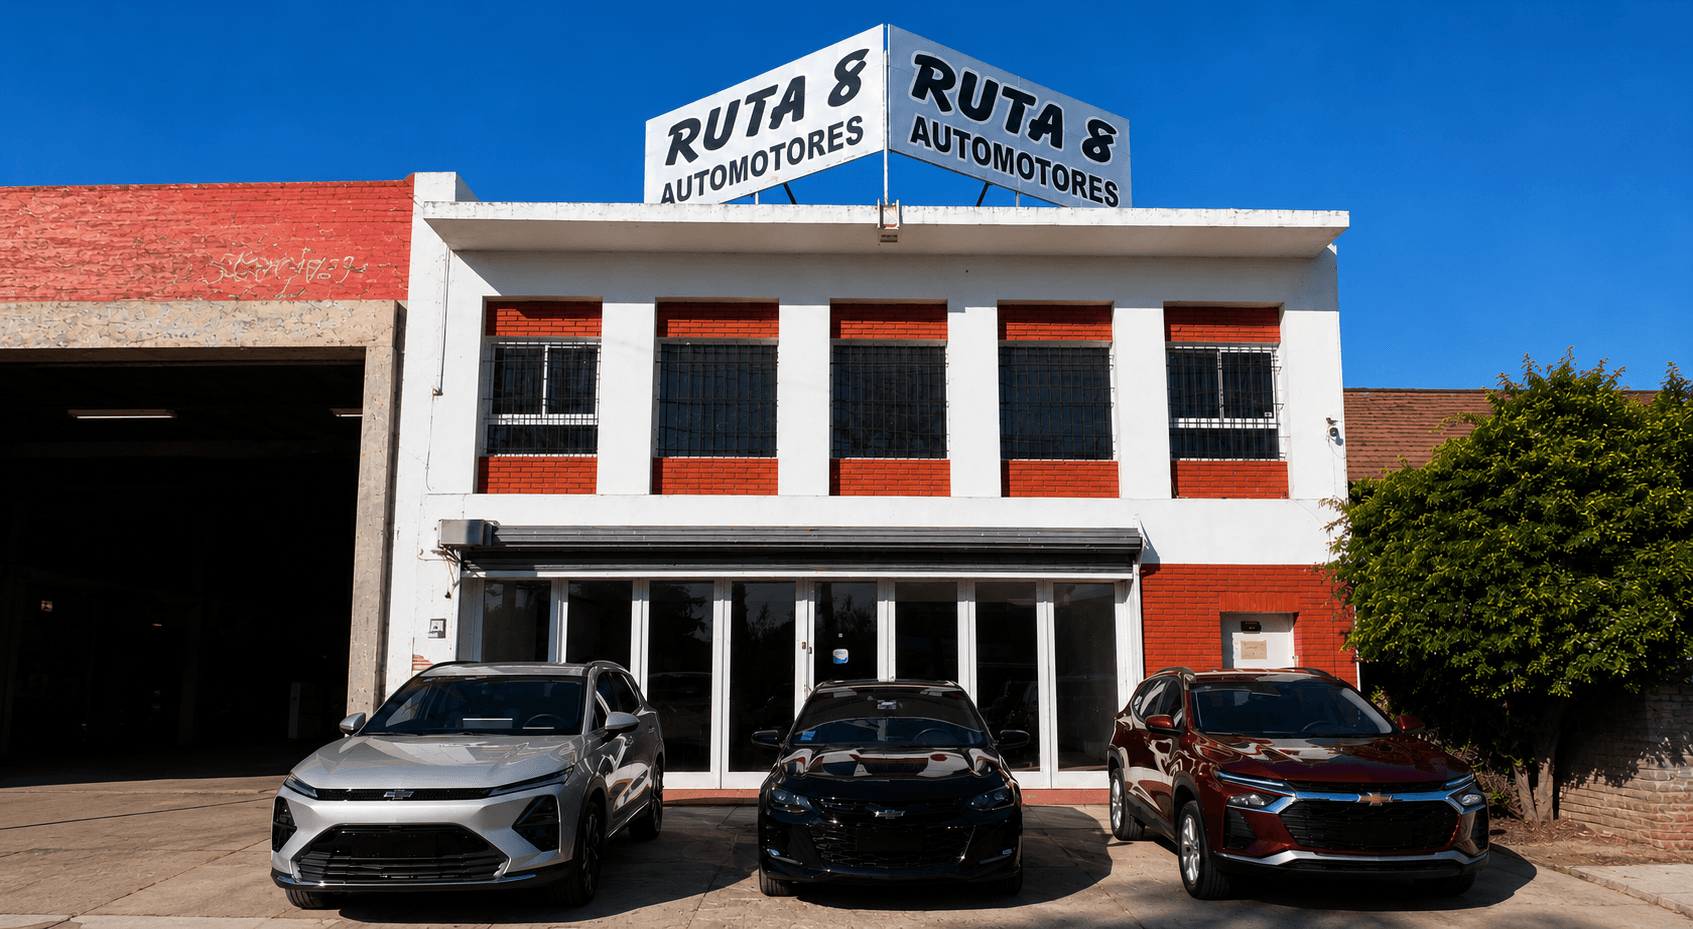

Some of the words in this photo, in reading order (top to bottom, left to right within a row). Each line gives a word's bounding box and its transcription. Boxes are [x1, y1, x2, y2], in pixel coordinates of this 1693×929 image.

[665, 75, 806, 166] RUTA
[828, 48, 870, 108] 8
[911, 53, 1064, 151] RUTA
[1081, 118, 1117, 163] 8
[660, 115, 864, 204] AUTOMOTORES
[909, 116, 1119, 208] AUTOMOTORES
